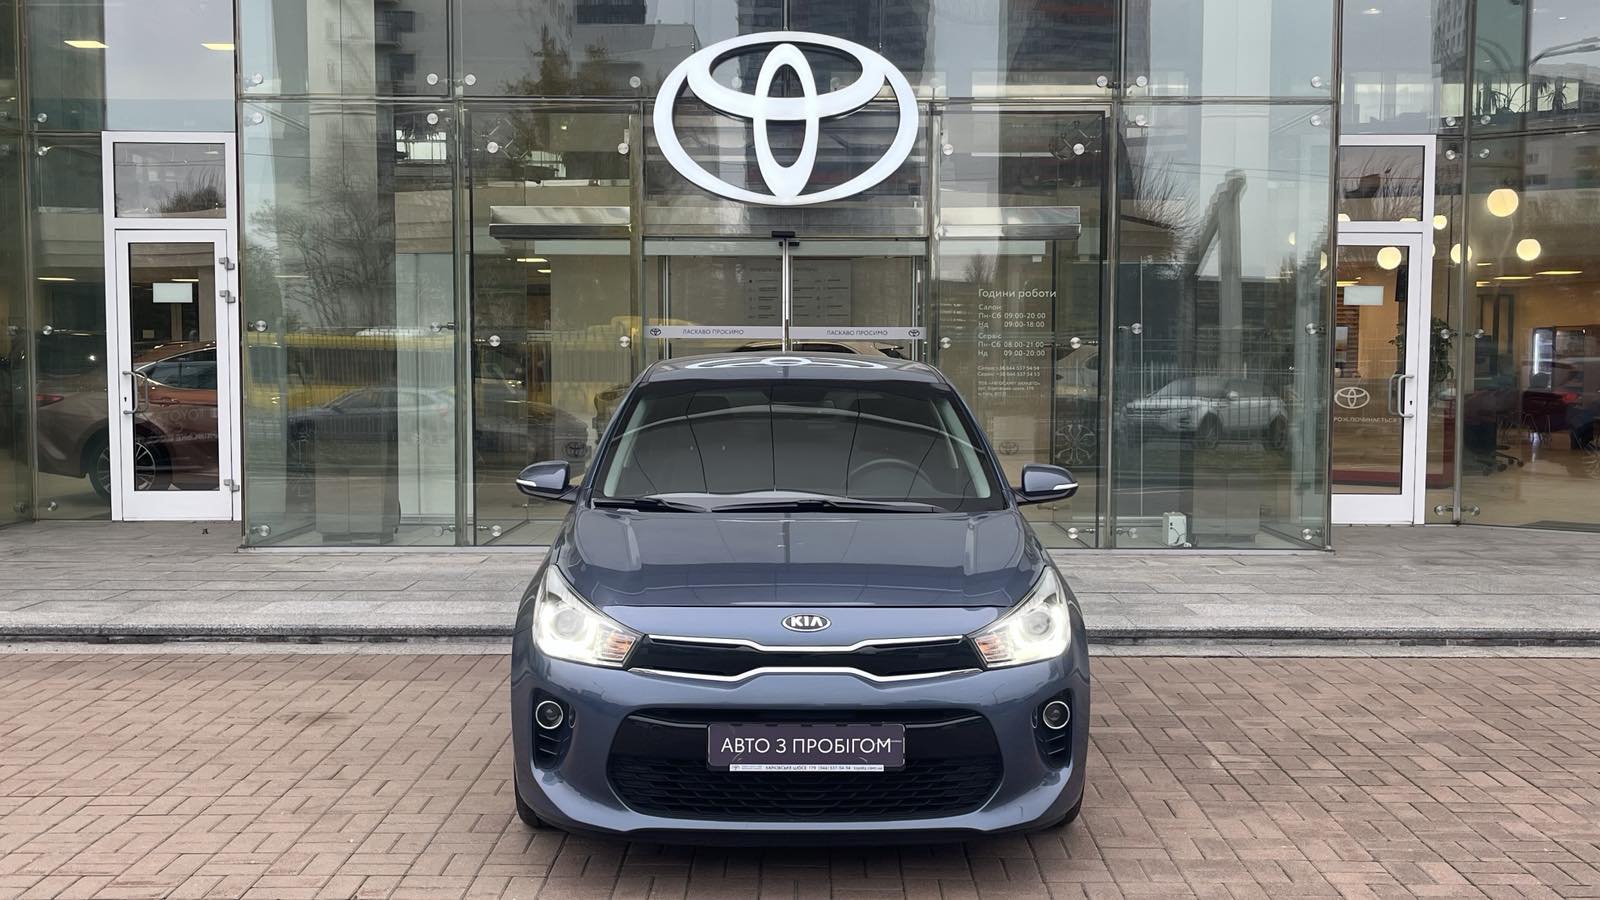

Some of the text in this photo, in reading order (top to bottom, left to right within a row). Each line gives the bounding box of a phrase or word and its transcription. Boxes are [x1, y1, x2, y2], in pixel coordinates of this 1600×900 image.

[978, 288, 1056, 300] Години роботи
[790, 616, 824, 627] KIA
[720, 738, 891, 753] АВТО З ПРОБІГОМ
